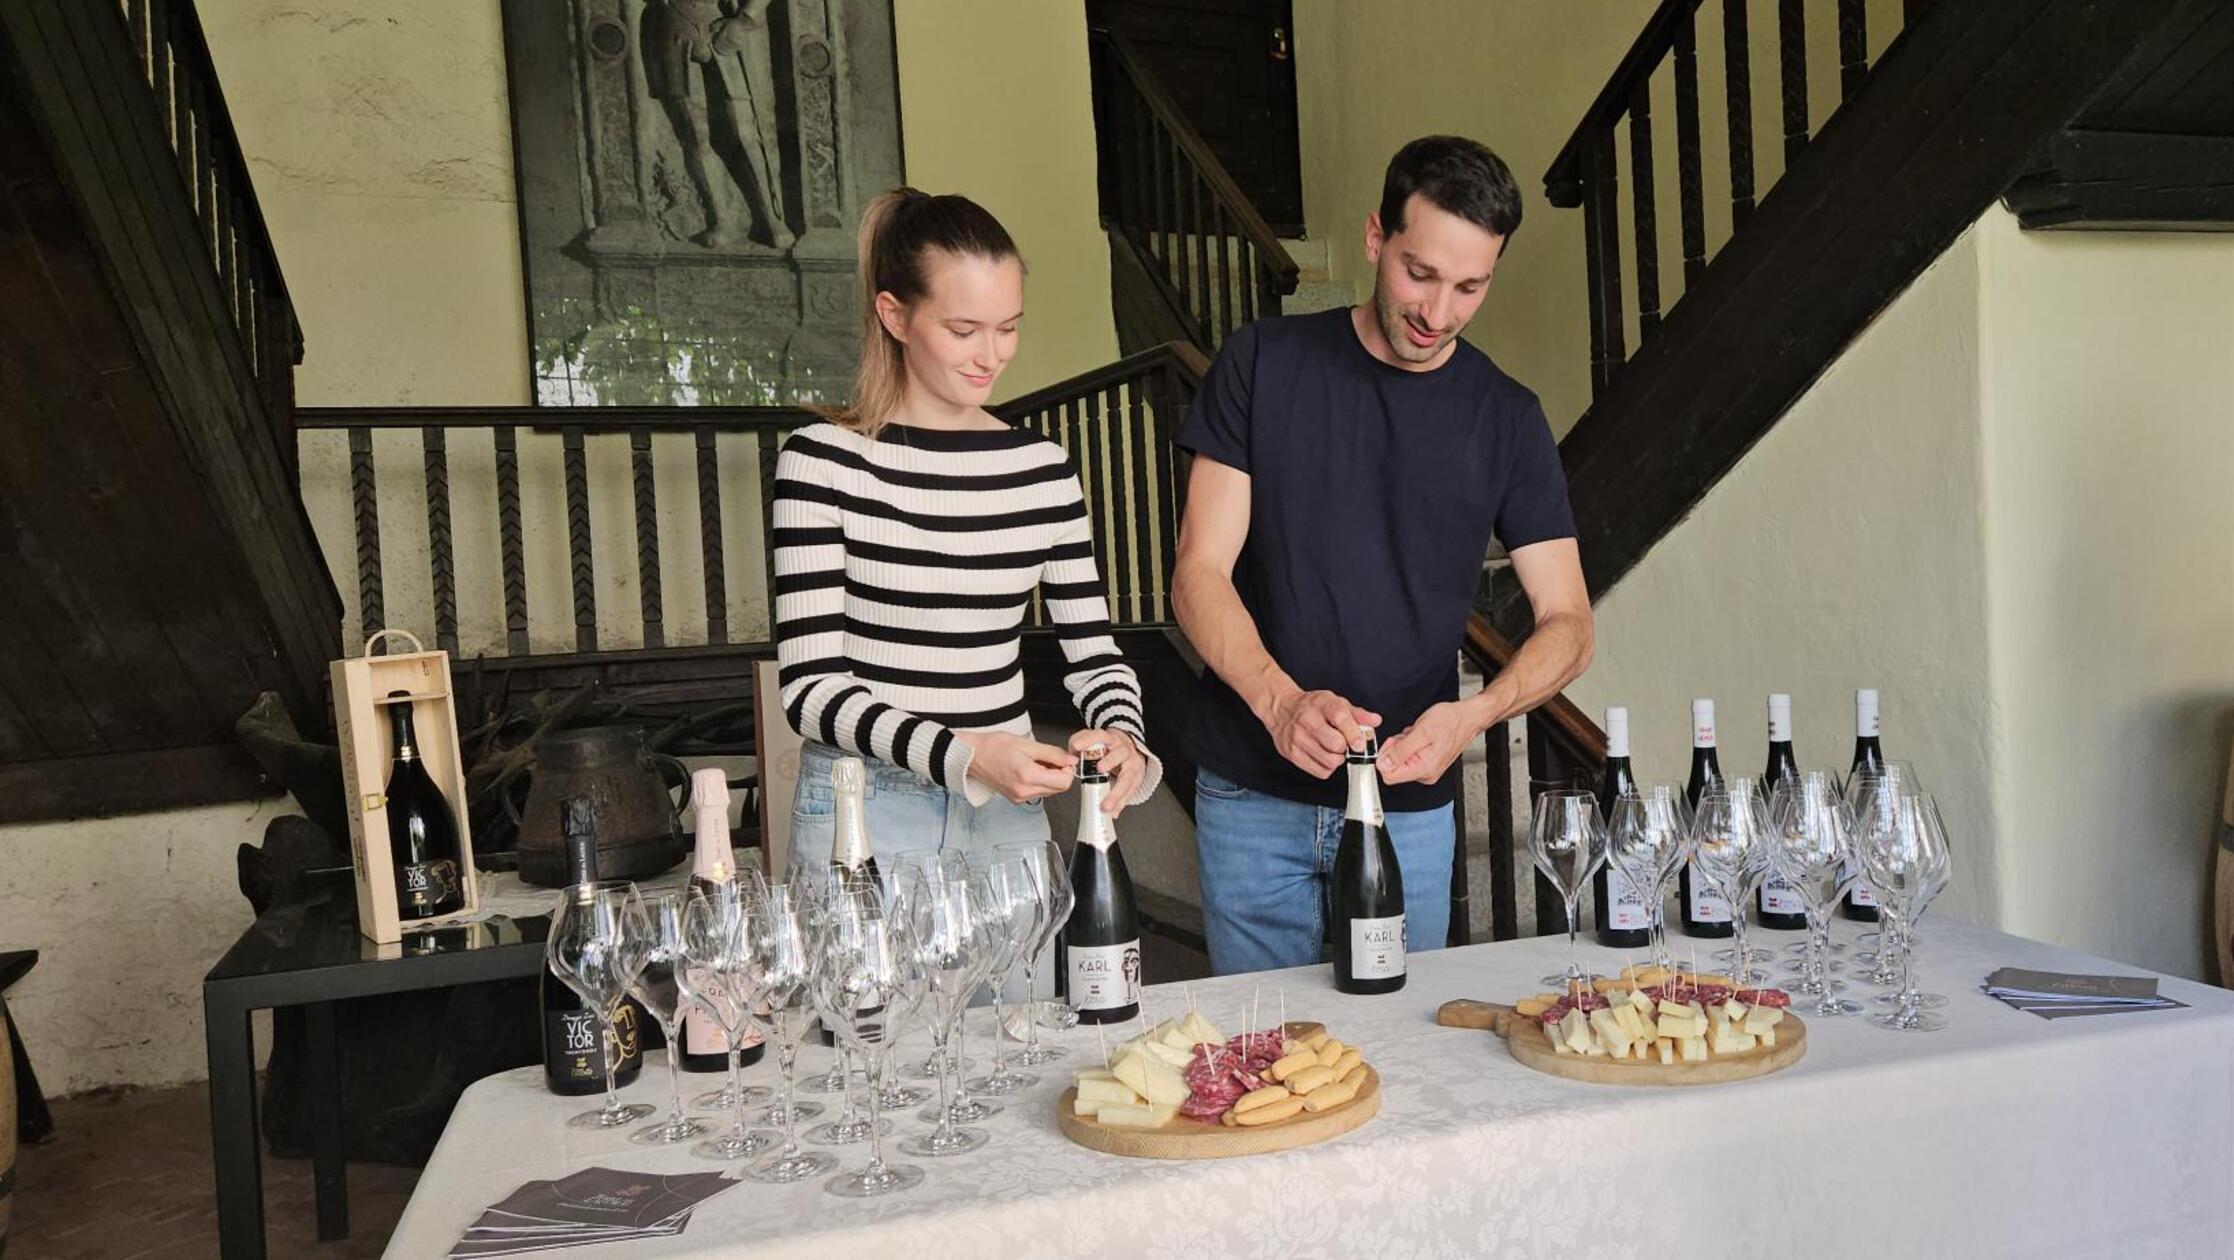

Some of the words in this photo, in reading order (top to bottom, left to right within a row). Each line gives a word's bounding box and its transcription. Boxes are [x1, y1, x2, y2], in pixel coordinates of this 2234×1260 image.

[1364, 930, 1395, 942] KARL
[1079, 960, 1111, 972] KARL
[567, 1020, 593, 1035] VIC
[566, 1034, 594, 1048] TOR
